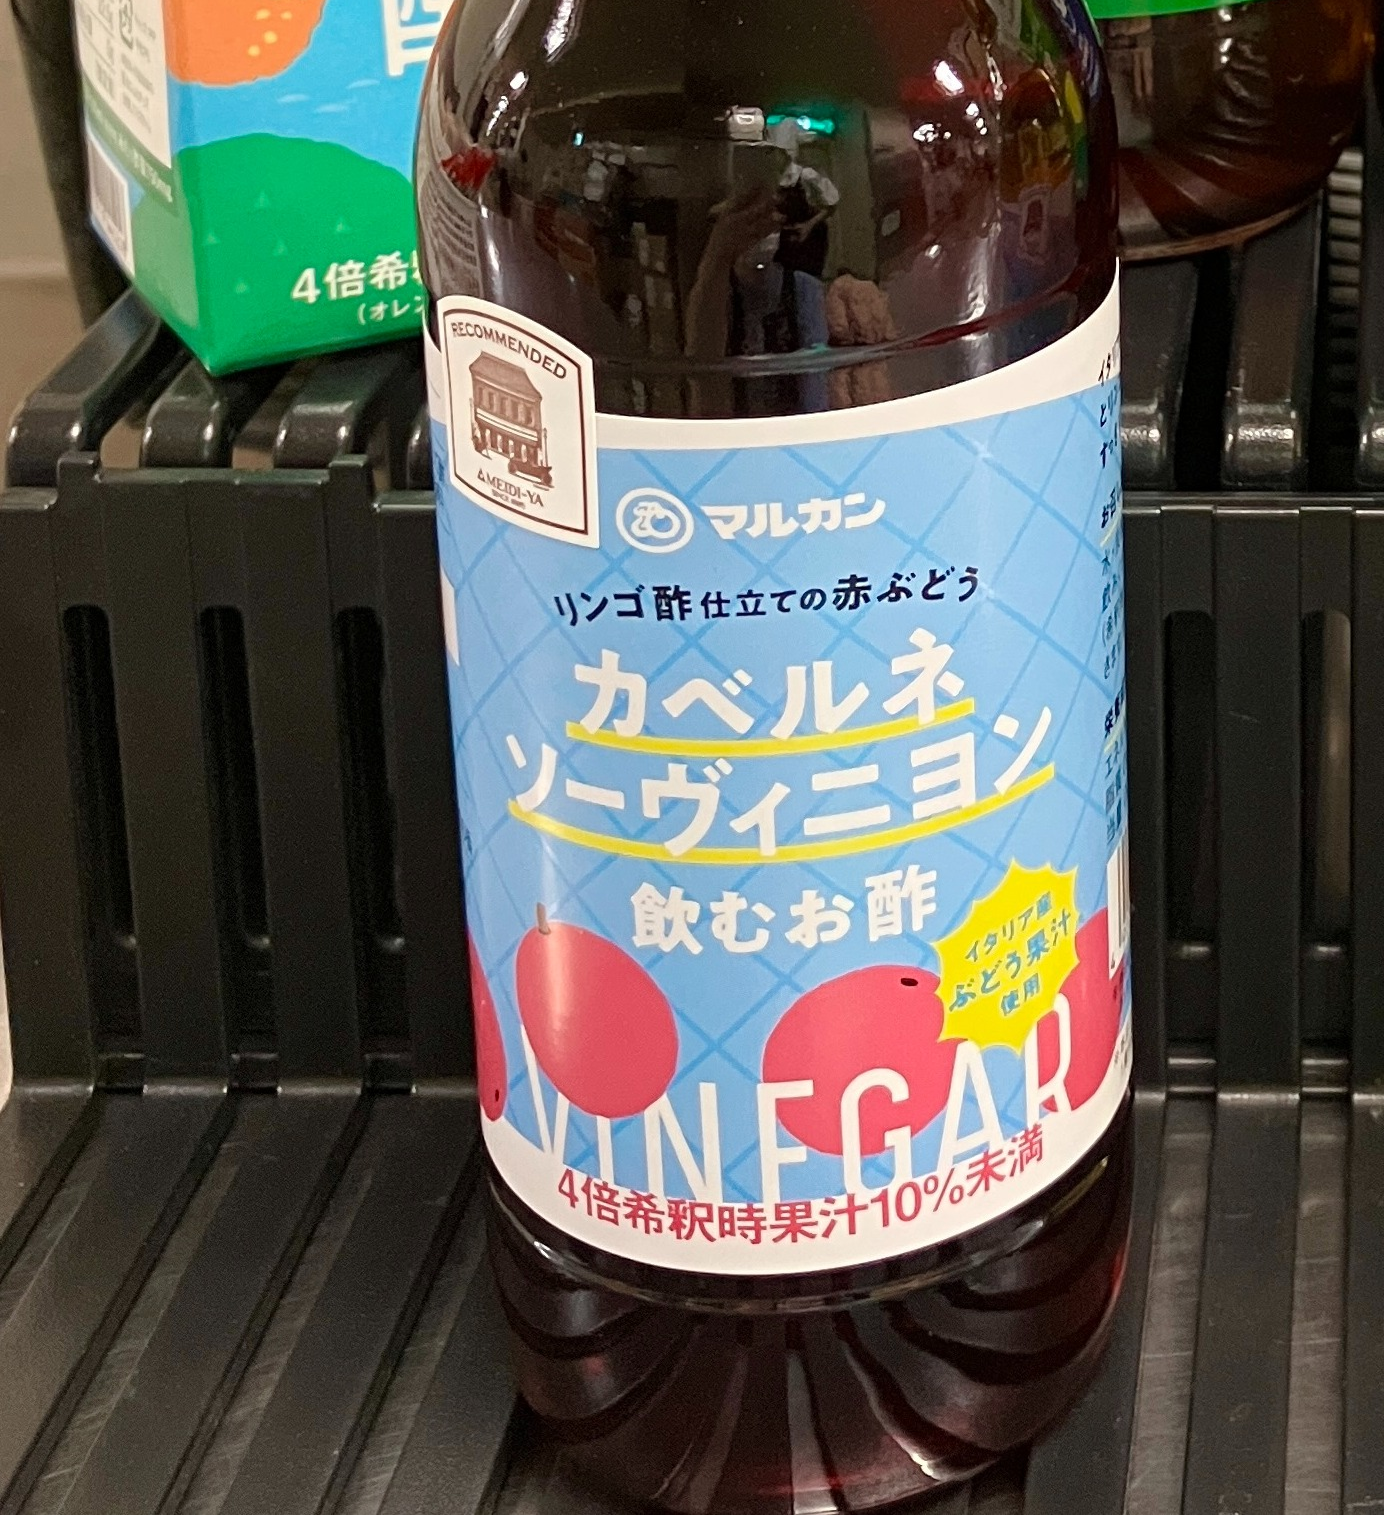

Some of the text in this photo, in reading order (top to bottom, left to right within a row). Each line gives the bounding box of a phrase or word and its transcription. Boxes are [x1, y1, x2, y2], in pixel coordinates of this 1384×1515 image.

[291, 250, 422, 304] 4倍希
[451, 321, 568, 381] RECOMMENDED
[701, 490, 887, 540] マルカン
[552, 565, 980, 627] リンゴ酢仕立ての赤ぶどう
[575, 627, 967, 740] カベルネ
[506, 705, 1053, 857] ソーヴィニヨン
[630, 865, 938, 956] 飲むお酢
[965, 889, 1055, 966] イタリア産
[948, 907, 1072, 1013] ぶどう果汁
[1001, 974, 1043, 1017] 使用
[520, 990, 1076, 1204] VINEGAR
[557, 1122, 1045, 1246] 4倍希釈時果汁10%未満
